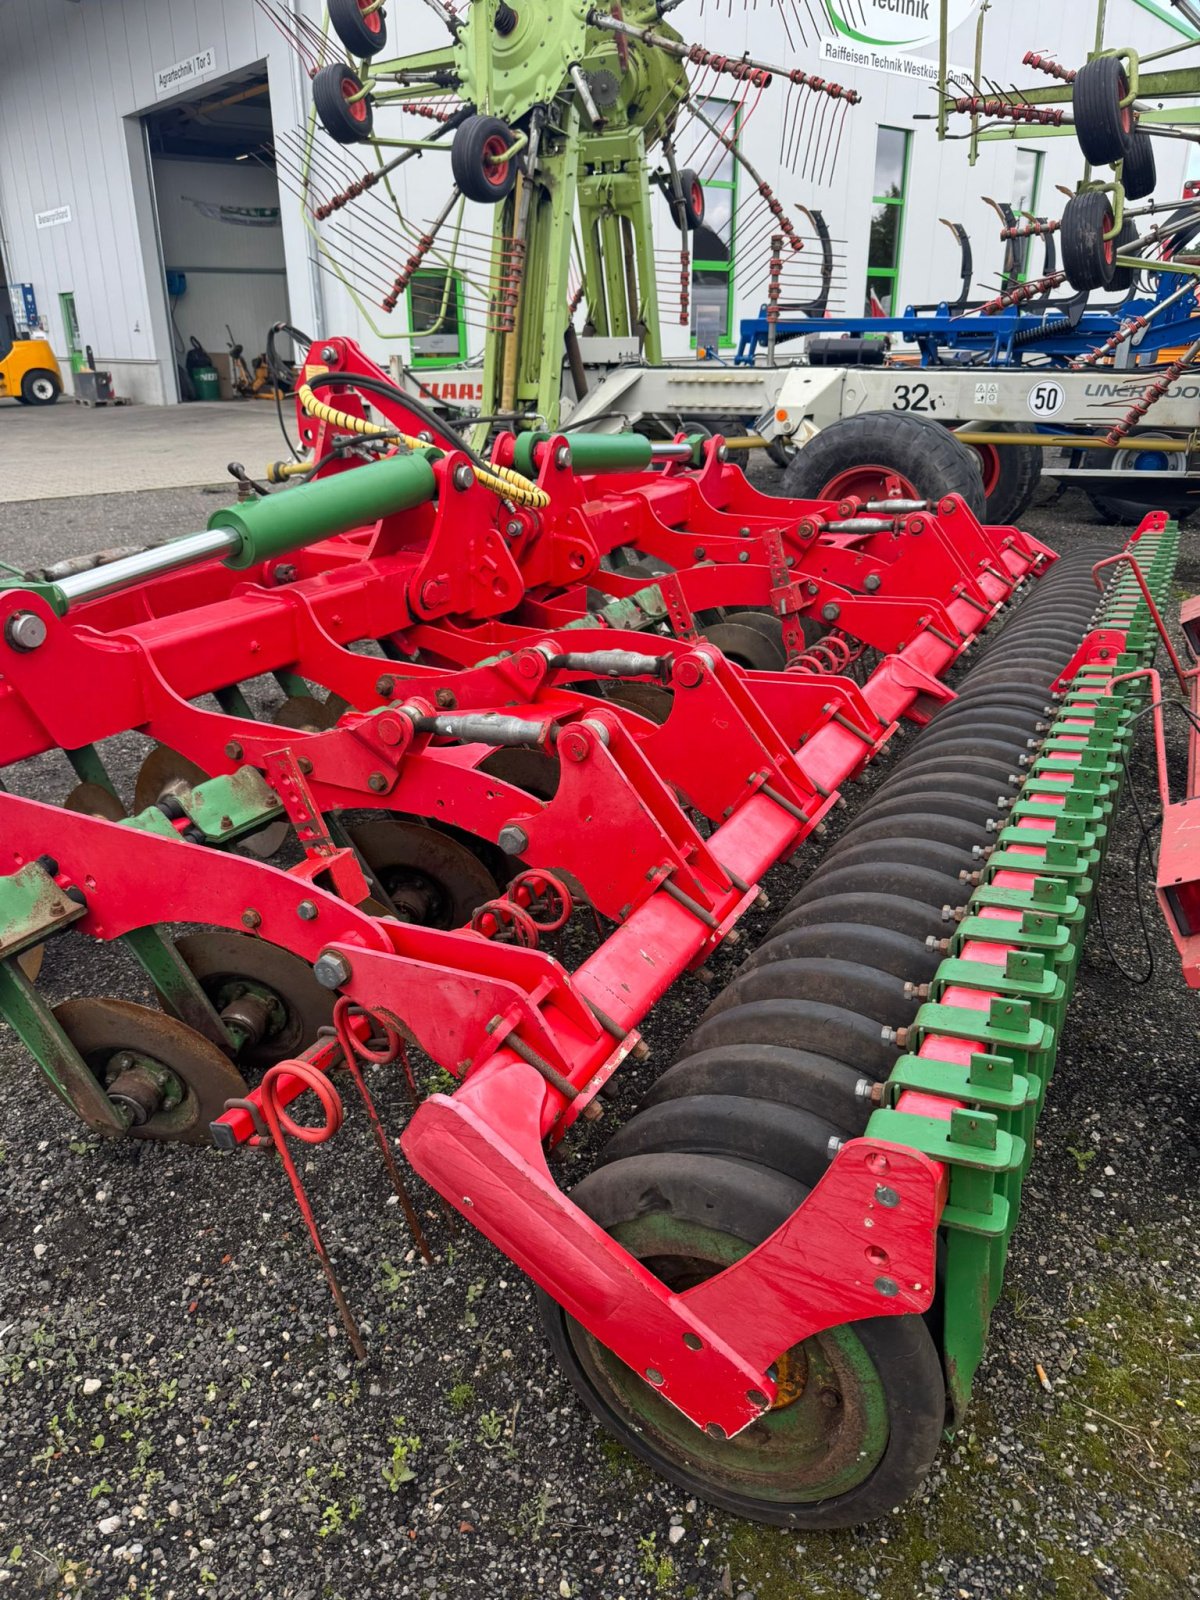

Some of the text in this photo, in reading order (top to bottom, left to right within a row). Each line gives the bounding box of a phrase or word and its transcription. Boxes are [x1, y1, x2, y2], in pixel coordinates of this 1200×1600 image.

[873, 0, 930, 20] echnik
[159, 61, 193, 88] Agrartechnik
[196, 57, 206, 71] Tor
[206, 52, 212, 66] 3
[825, 43, 869, 65] Raiffeisen
[871, 53, 902, 72] Technik
[903, 60, 938, 79] Westküs
[1034, 387, 1058, 411] 50
[1085, 384, 1146, 398] LINER
